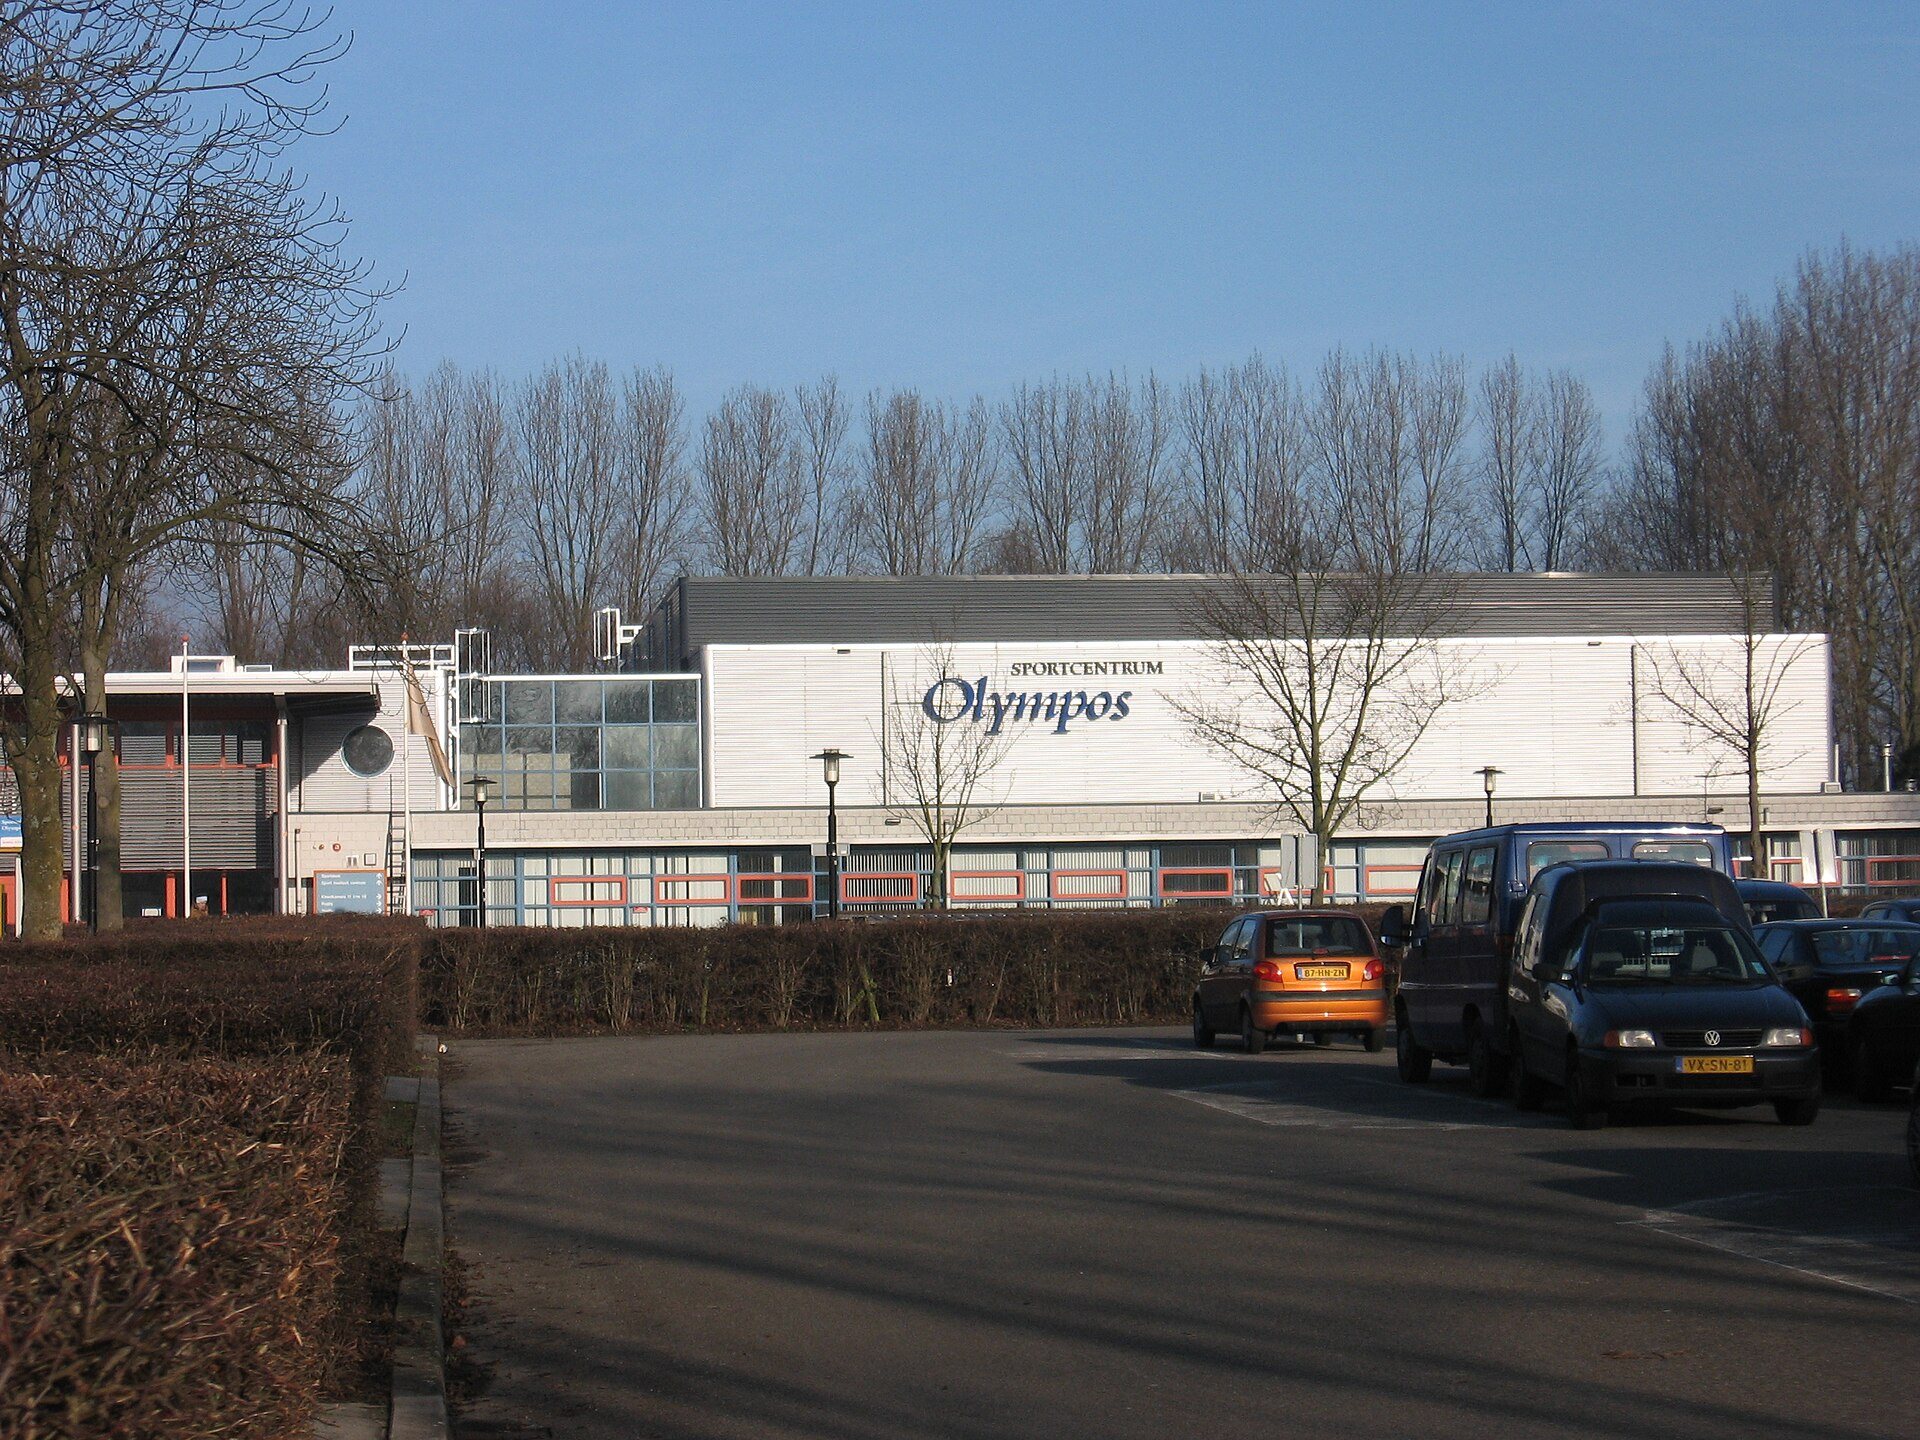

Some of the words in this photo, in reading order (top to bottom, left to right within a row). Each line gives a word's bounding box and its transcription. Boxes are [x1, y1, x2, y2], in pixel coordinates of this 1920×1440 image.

[1010, 661, 1164, 676] SPORTCENTRUM
[922, 676, 1133, 736] Olympos
[1304, 969, 1345, 977] 87-HN-ZN
[1687, 1059, 1748, 1072] VX-SN-81
